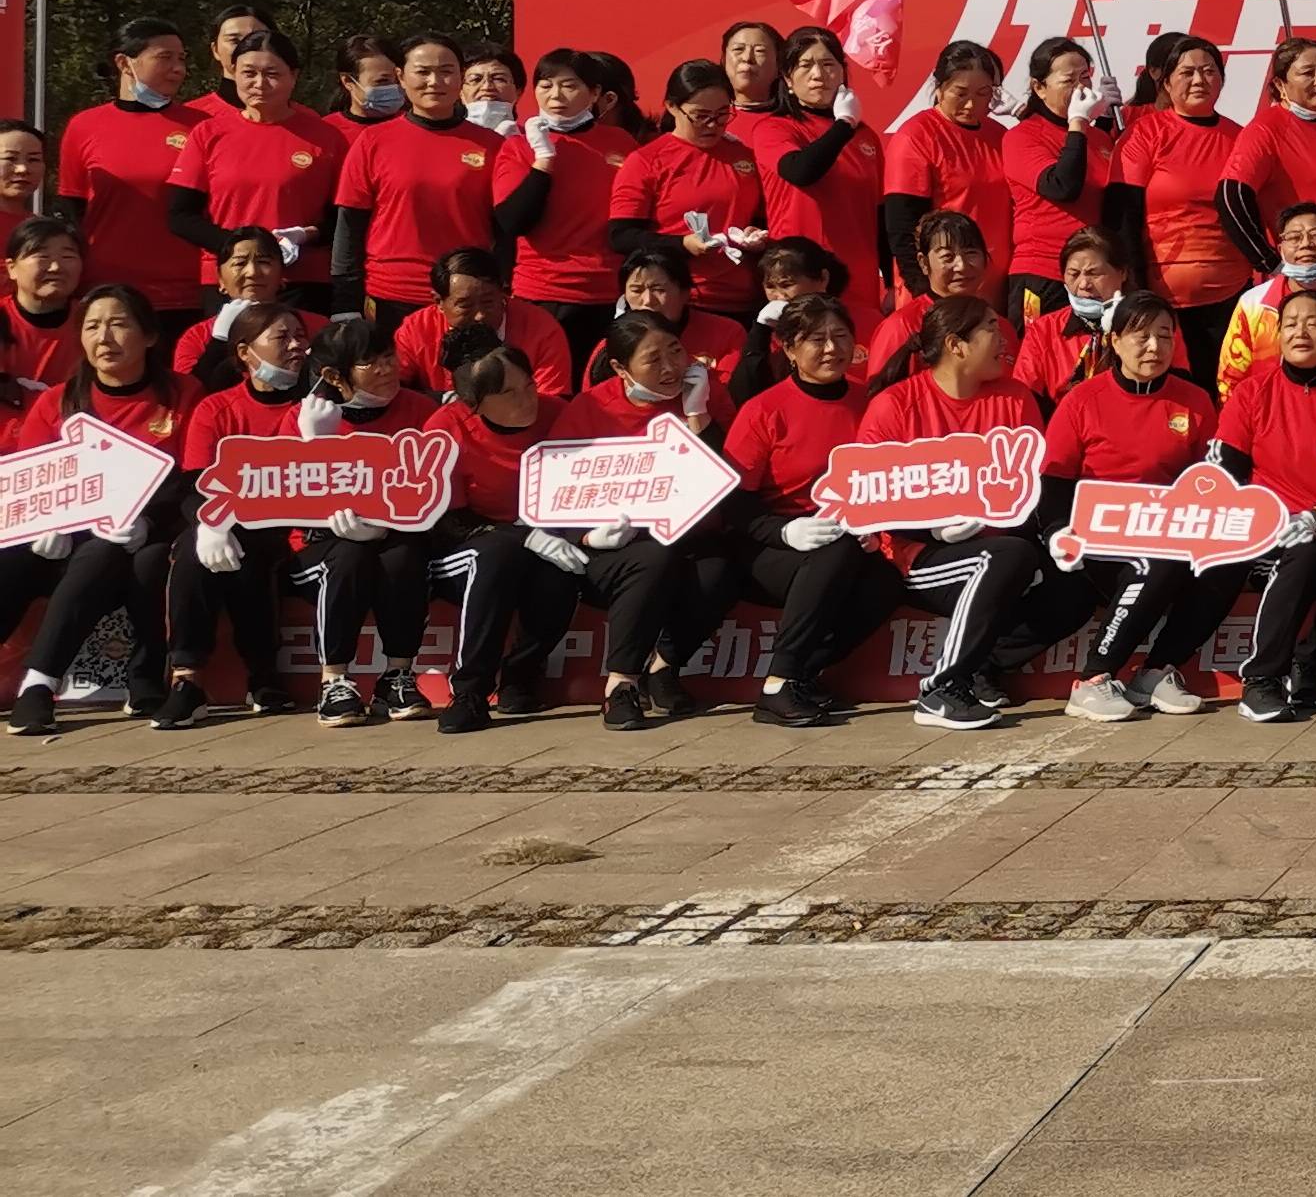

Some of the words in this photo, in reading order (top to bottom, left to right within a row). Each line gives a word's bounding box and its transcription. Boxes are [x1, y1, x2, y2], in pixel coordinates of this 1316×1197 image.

[237, 460, 374, 500] 加把劲
[570, 450, 658, 481] 中国劲酒
[847, 458, 971, 505] 加把劲
[550, 475, 675, 513] 健康跑中国
[1088, 503, 1256, 542] C位出道
